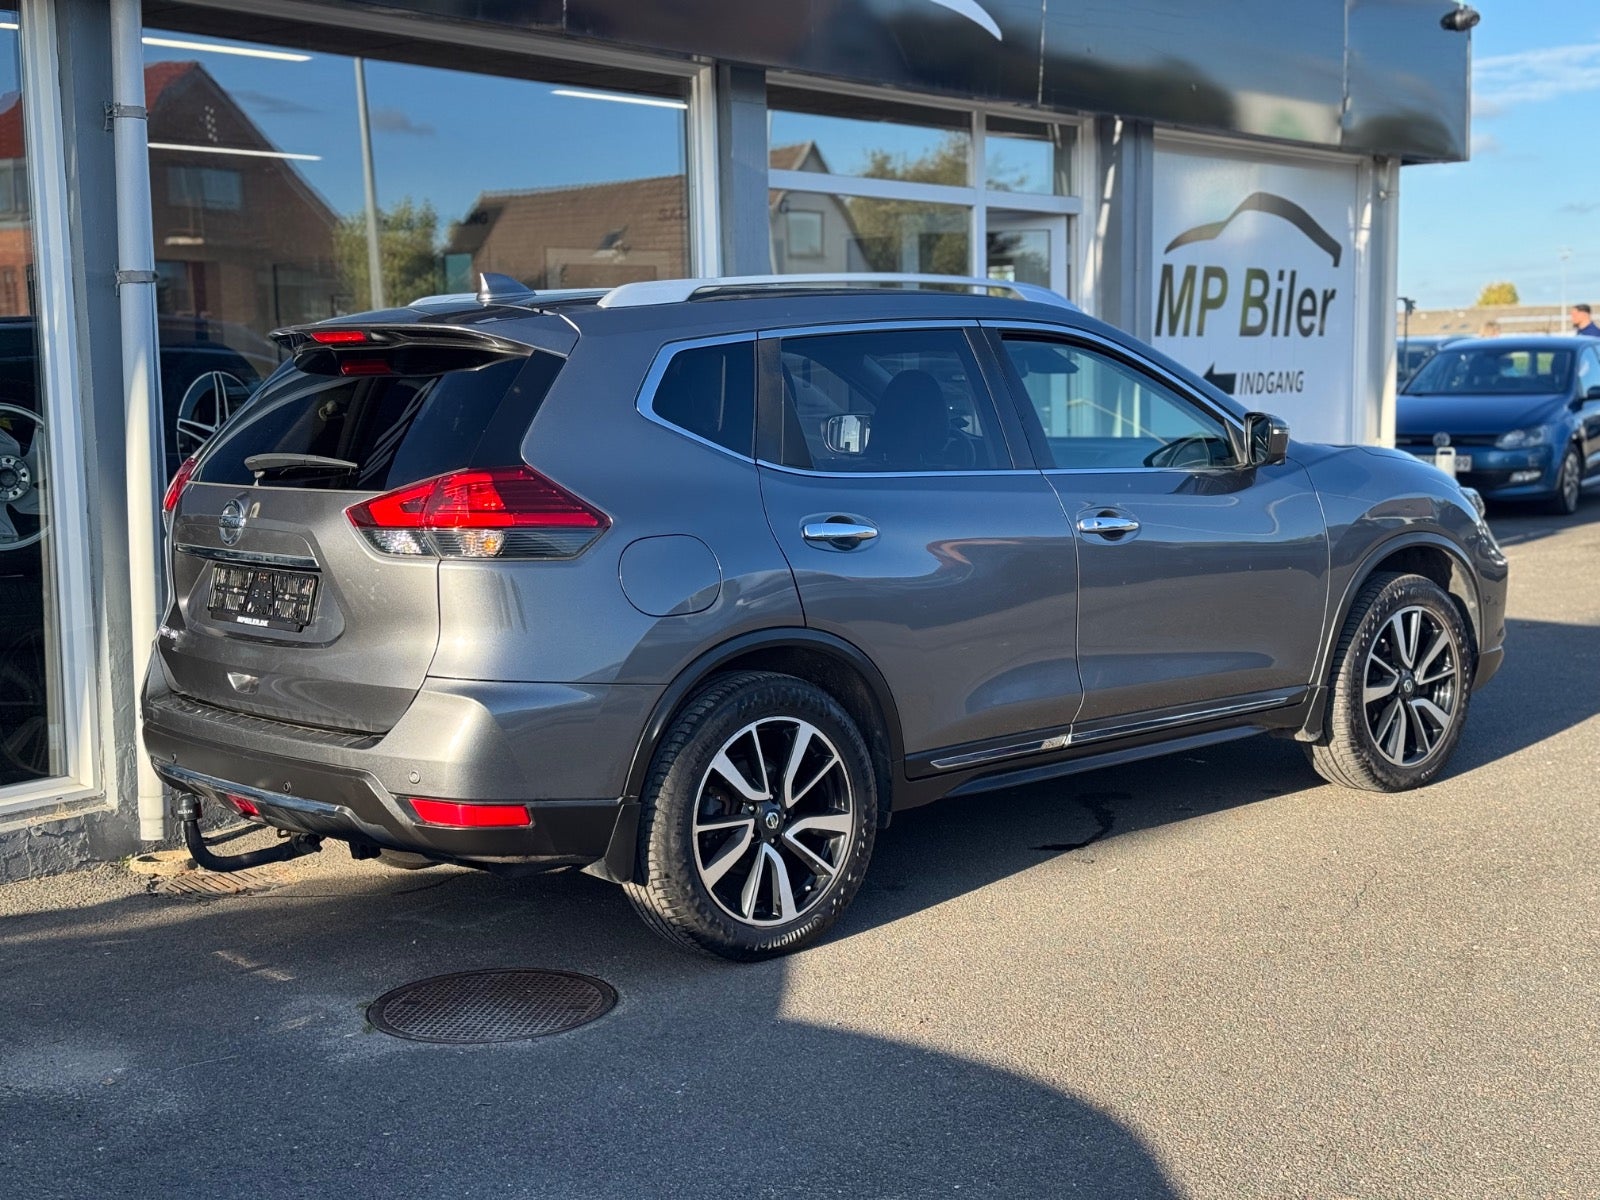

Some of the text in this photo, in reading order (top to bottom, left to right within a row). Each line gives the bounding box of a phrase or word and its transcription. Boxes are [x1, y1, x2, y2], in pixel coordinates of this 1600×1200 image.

[1155, 264, 1337, 338] MP Biler
[1239, 371, 1305, 395] INDGANG
